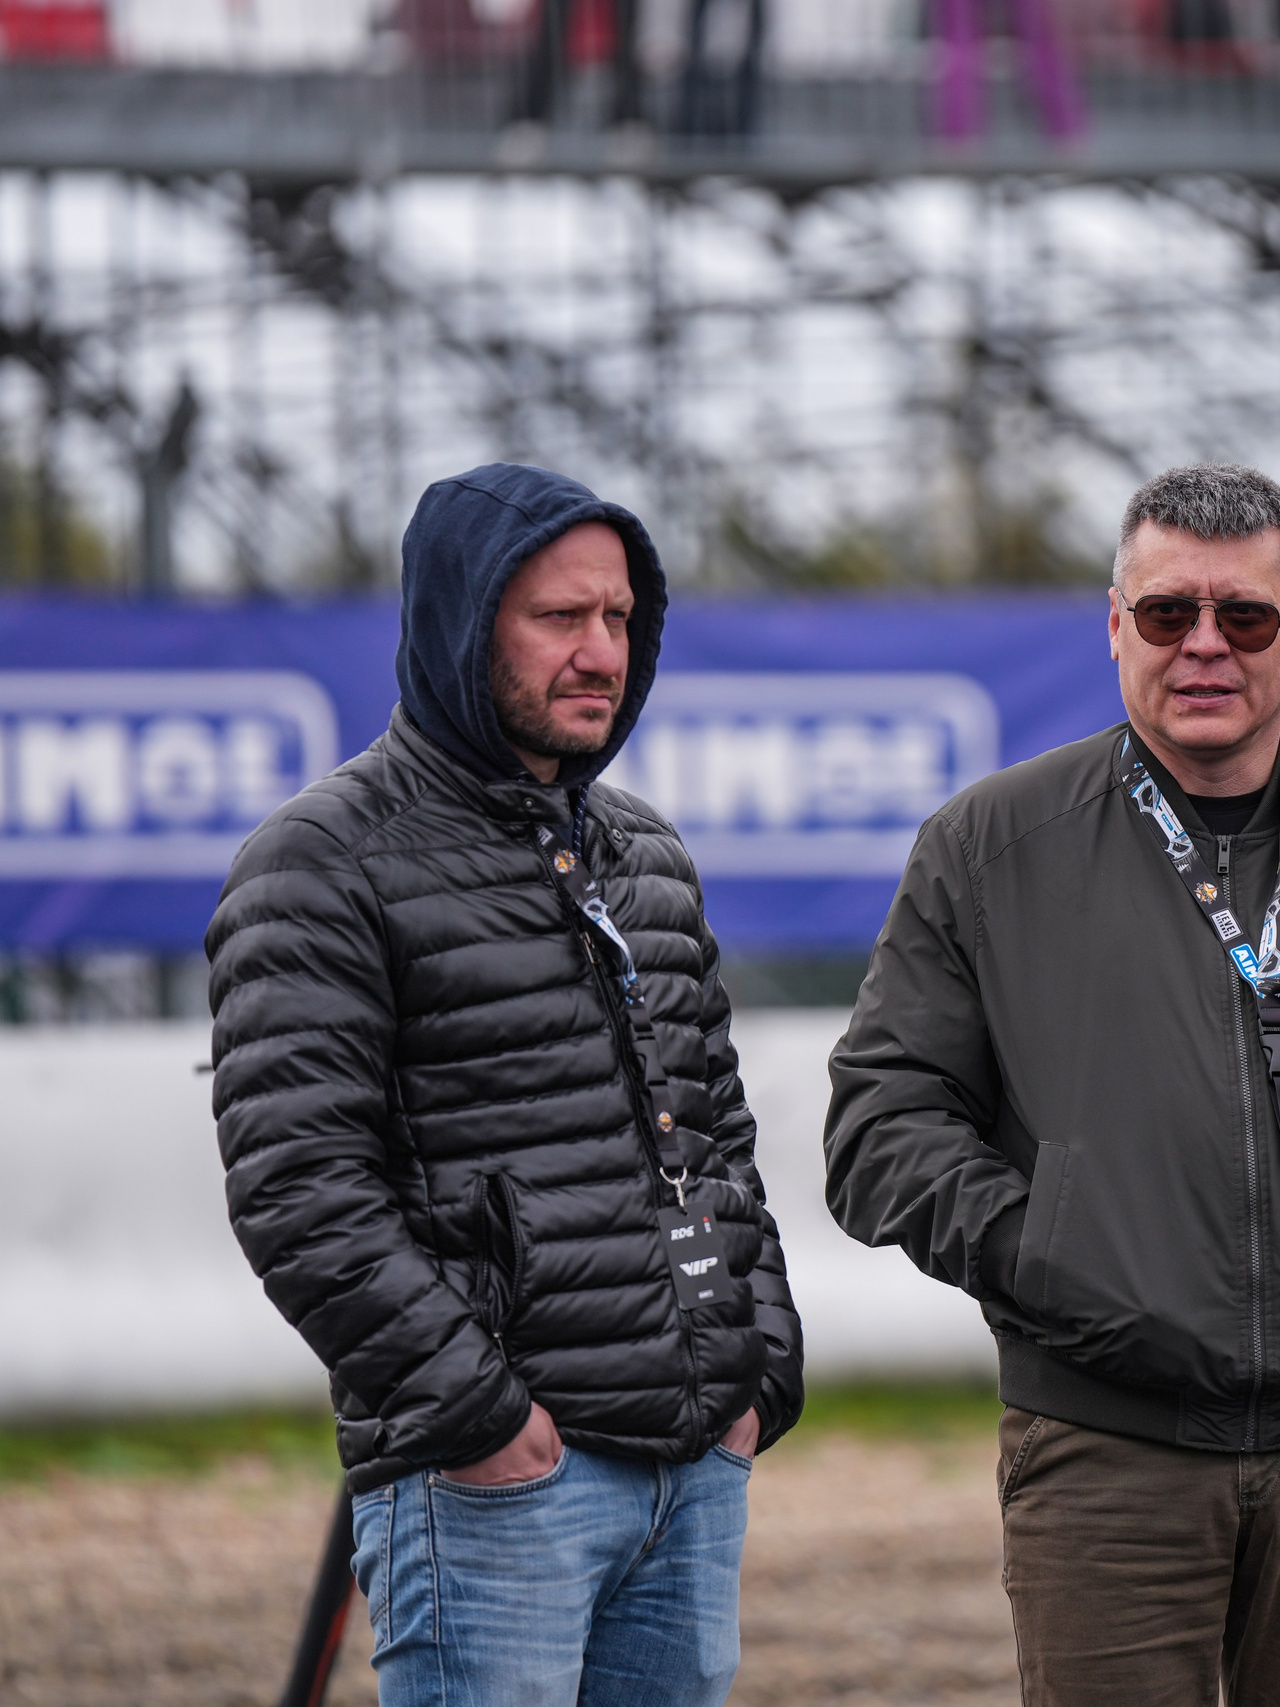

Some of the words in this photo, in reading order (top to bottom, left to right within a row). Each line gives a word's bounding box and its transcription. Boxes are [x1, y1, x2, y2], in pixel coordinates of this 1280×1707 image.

[1234, 949, 1259, 980] AIM
[671, 1225, 695, 1241] RDS
[679, 1256, 718, 1277] VIP
